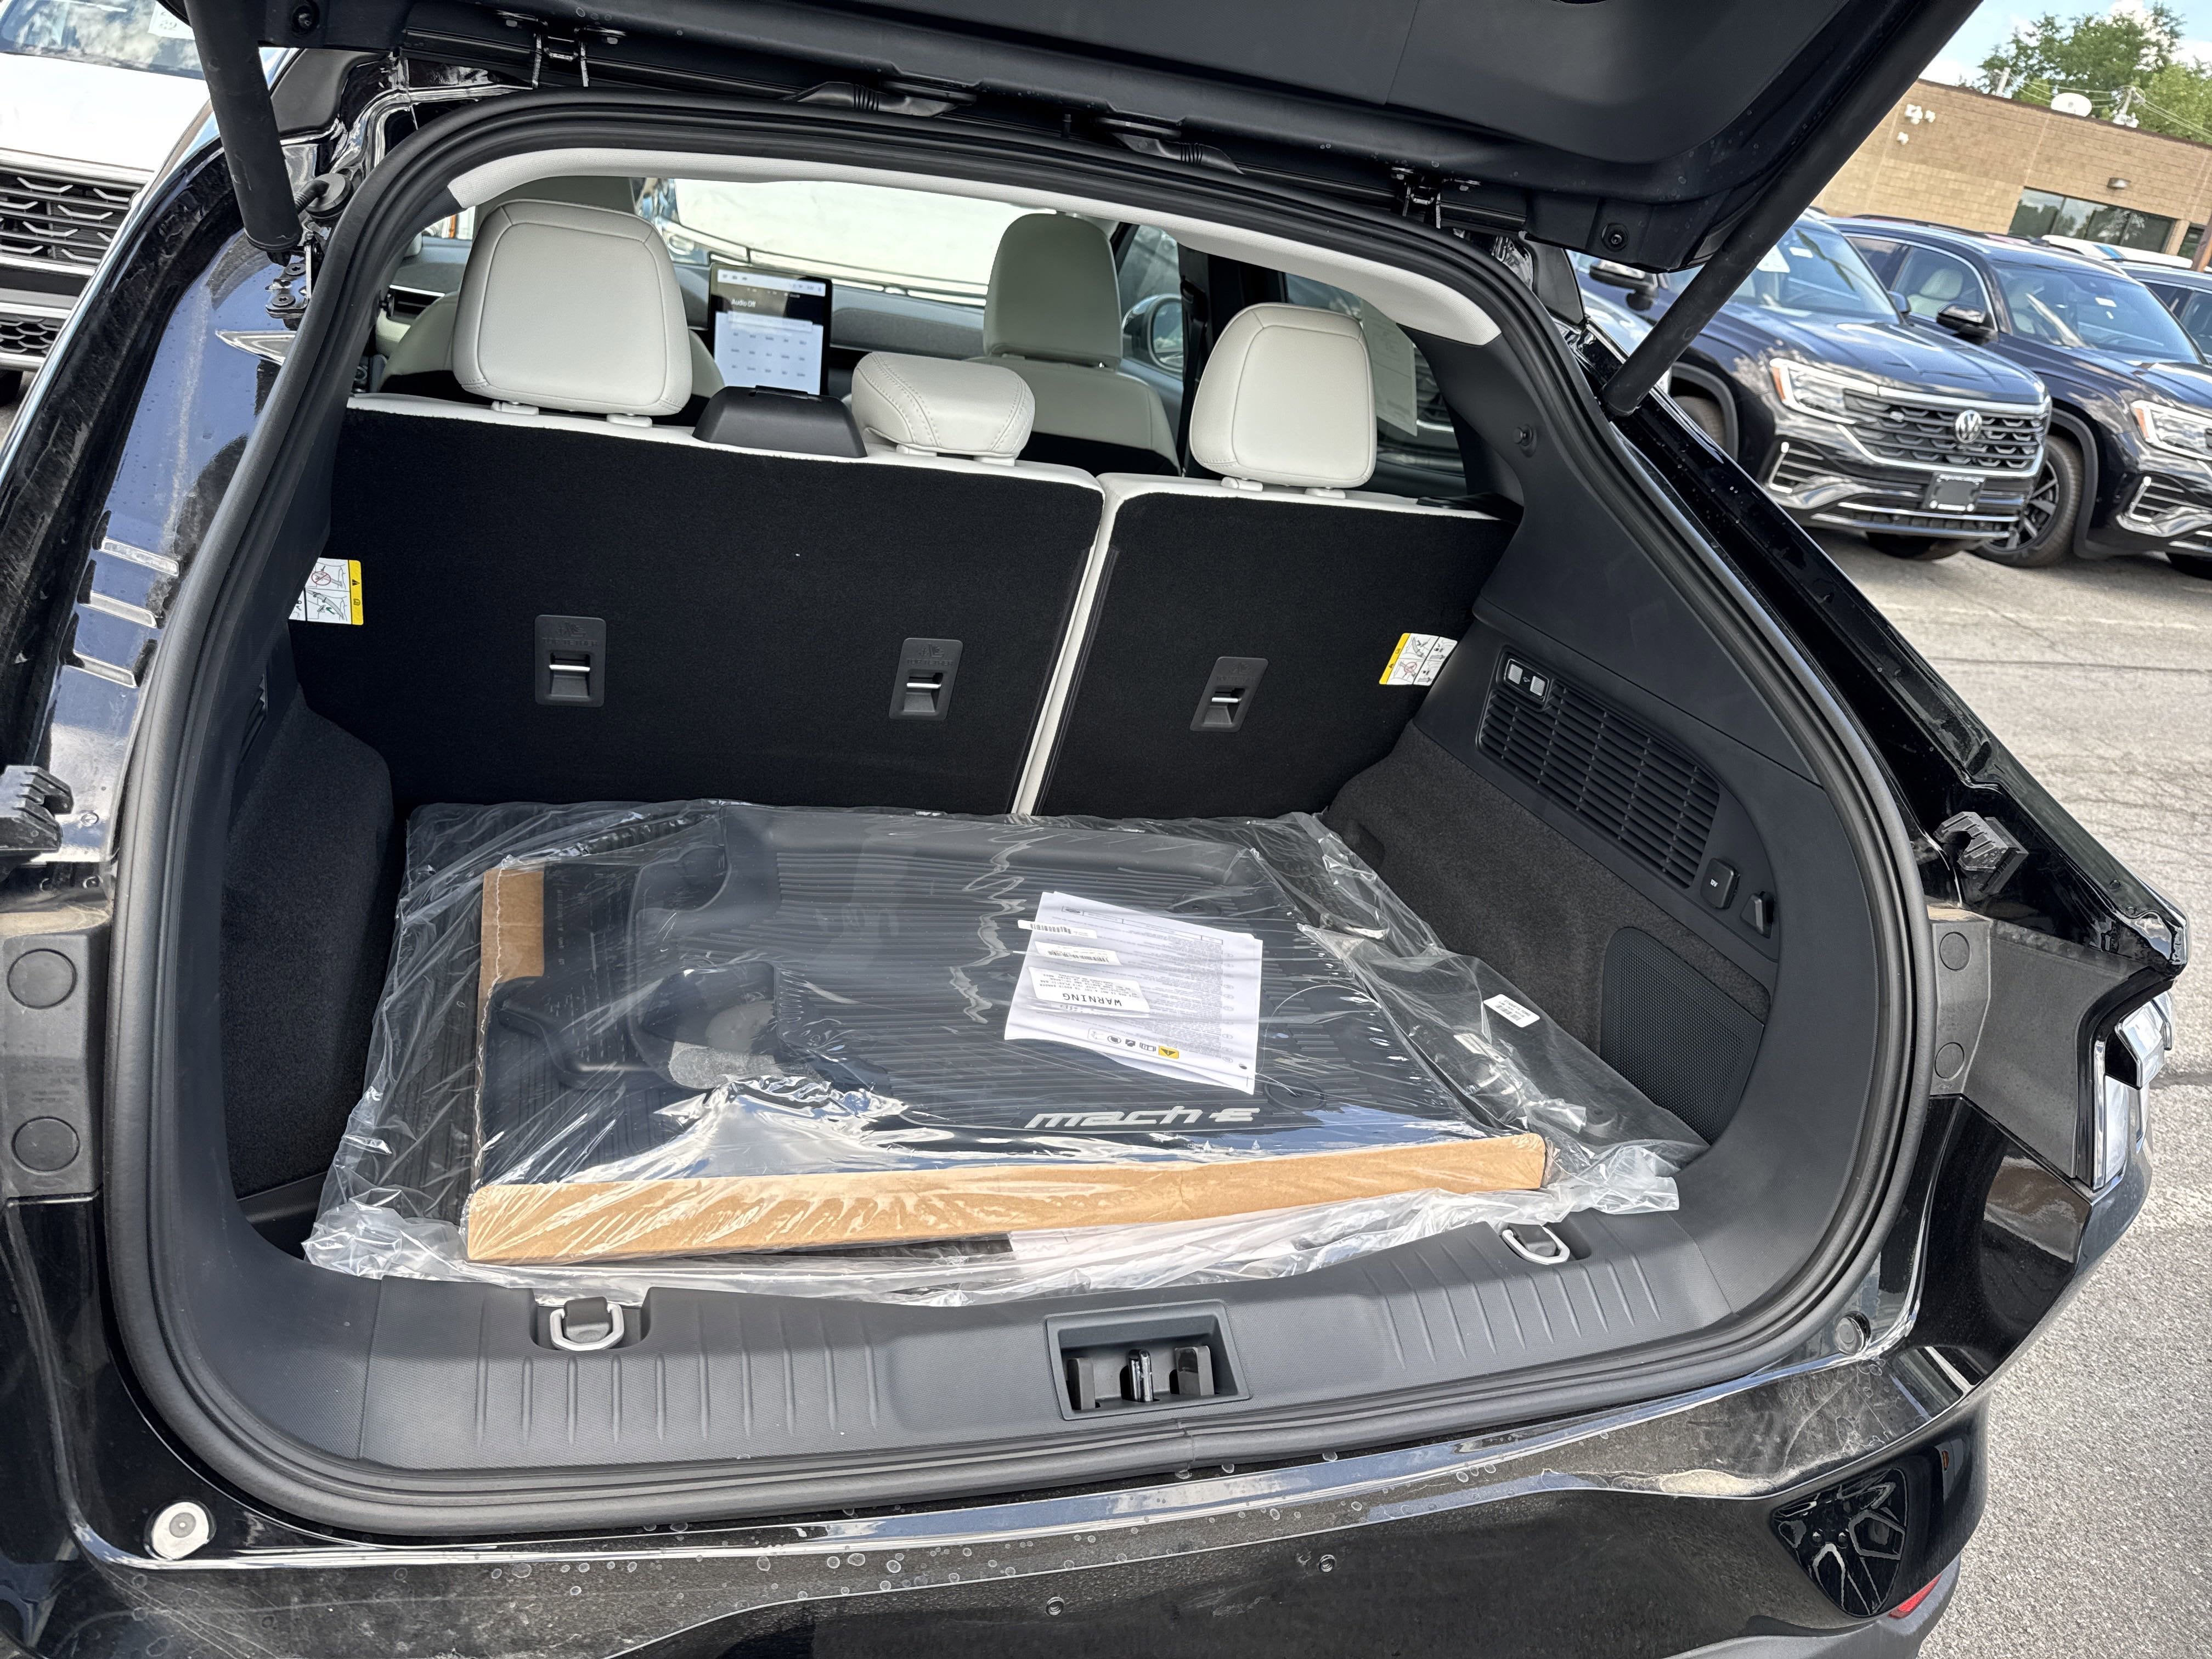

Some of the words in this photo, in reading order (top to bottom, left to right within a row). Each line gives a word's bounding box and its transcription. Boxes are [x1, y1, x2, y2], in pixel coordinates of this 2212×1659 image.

[731, 298, 747, 307] Audio
[1710, 878, 1718, 887] 12V
[1062, 993, 1122, 1007] WARNING
